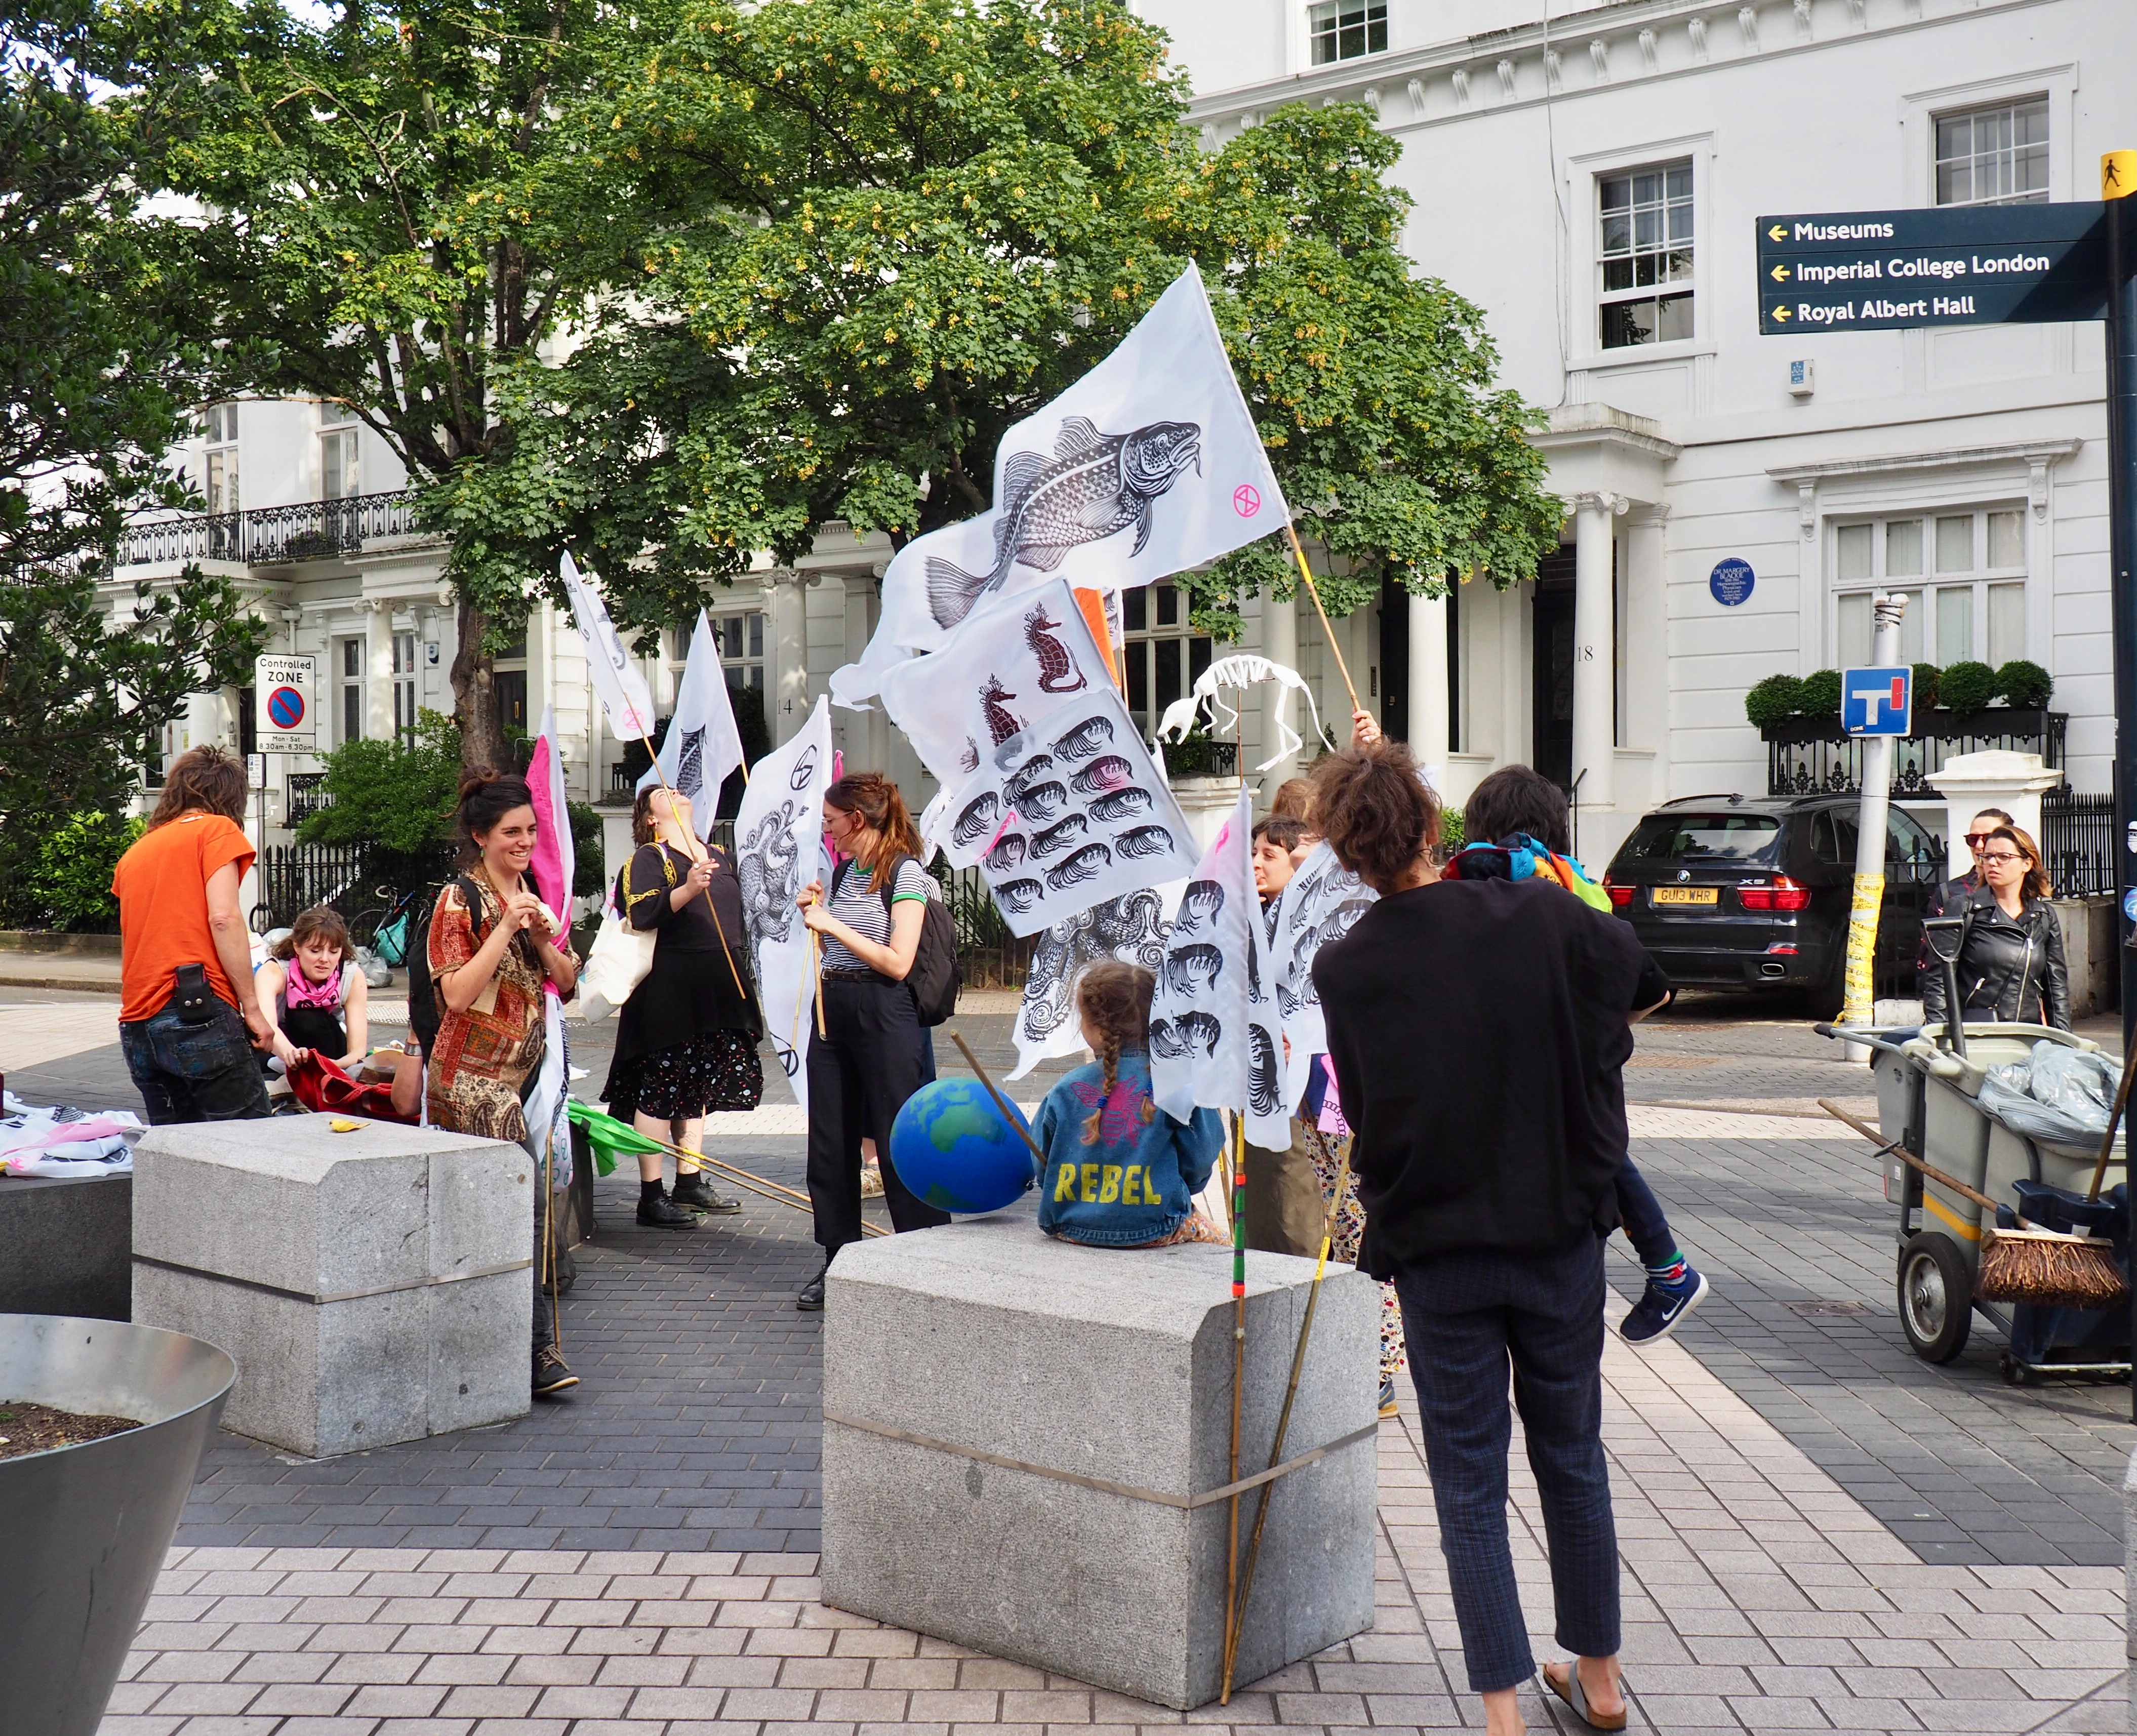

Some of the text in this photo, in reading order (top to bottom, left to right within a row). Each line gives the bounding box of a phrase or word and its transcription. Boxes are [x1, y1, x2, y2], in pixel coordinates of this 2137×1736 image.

[1795, 223, 1894, 241] Museums
[1797, 254, 2049, 285] Imperial College London
[1798, 296, 1975, 325] Royal Albert Hall
[1578, 645, 1593, 662] 18
[260, 659, 311, 669] Controlled
[268, 671, 303, 683] ZONE
[778, 699, 793, 715] 14
[1689, 890, 1710, 902] WHR
[1054, 1163, 1161, 1205] REBEL
